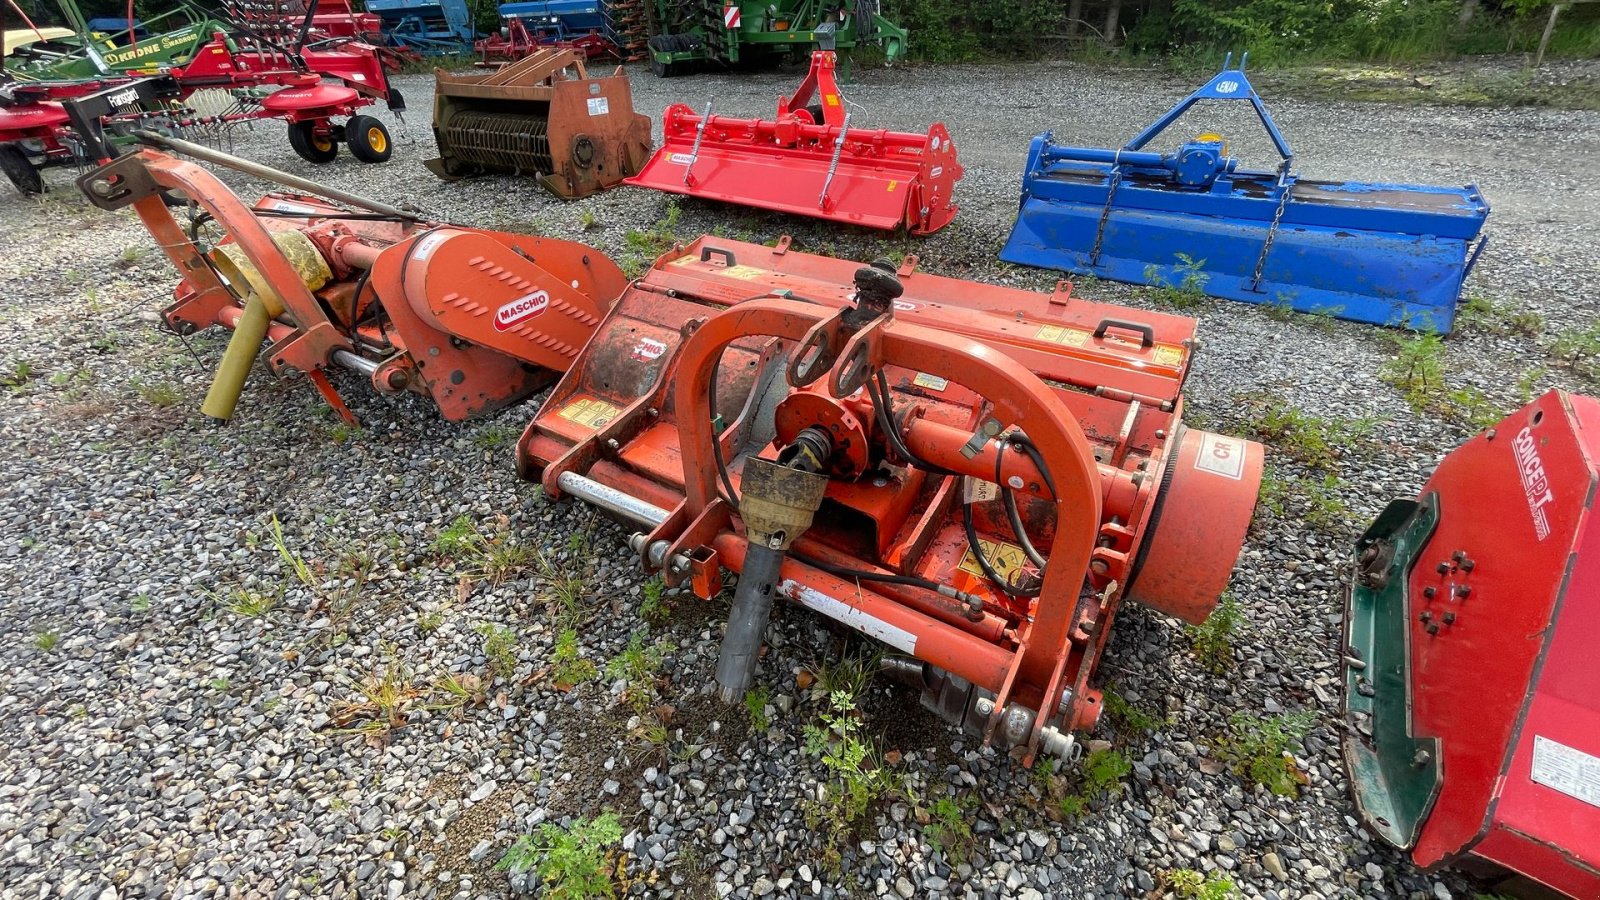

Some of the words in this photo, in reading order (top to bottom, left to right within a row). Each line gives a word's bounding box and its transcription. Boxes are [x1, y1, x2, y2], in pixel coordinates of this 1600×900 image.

[118, 43, 161, 62] KRONE
[106, 87, 140, 108] Fransgard
[500, 294, 547, 321] MASCHIO
[1212, 441, 1232, 460] CR
[1516, 426, 1554, 510] CONCEPT
